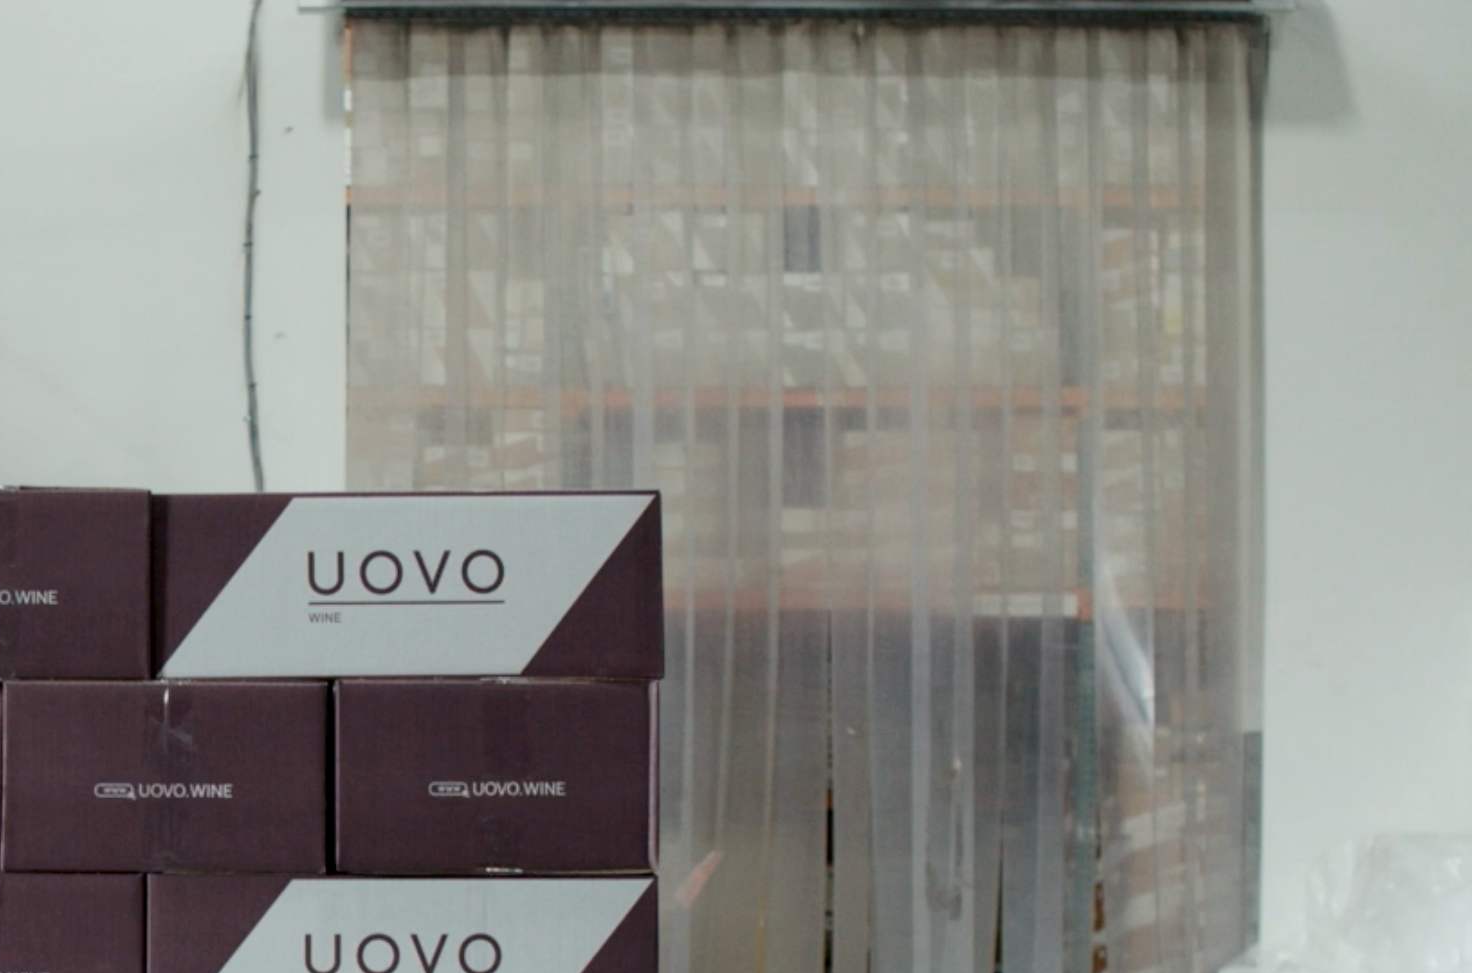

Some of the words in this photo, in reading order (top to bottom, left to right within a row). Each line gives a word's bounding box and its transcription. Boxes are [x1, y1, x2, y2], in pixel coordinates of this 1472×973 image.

[307, 548, 506, 597] UOVO
[307, 612, 342, 624] WINE
[138, 783, 233, 799] UOVO.WINE
[472, 780, 568, 797] UOVO.WINE
